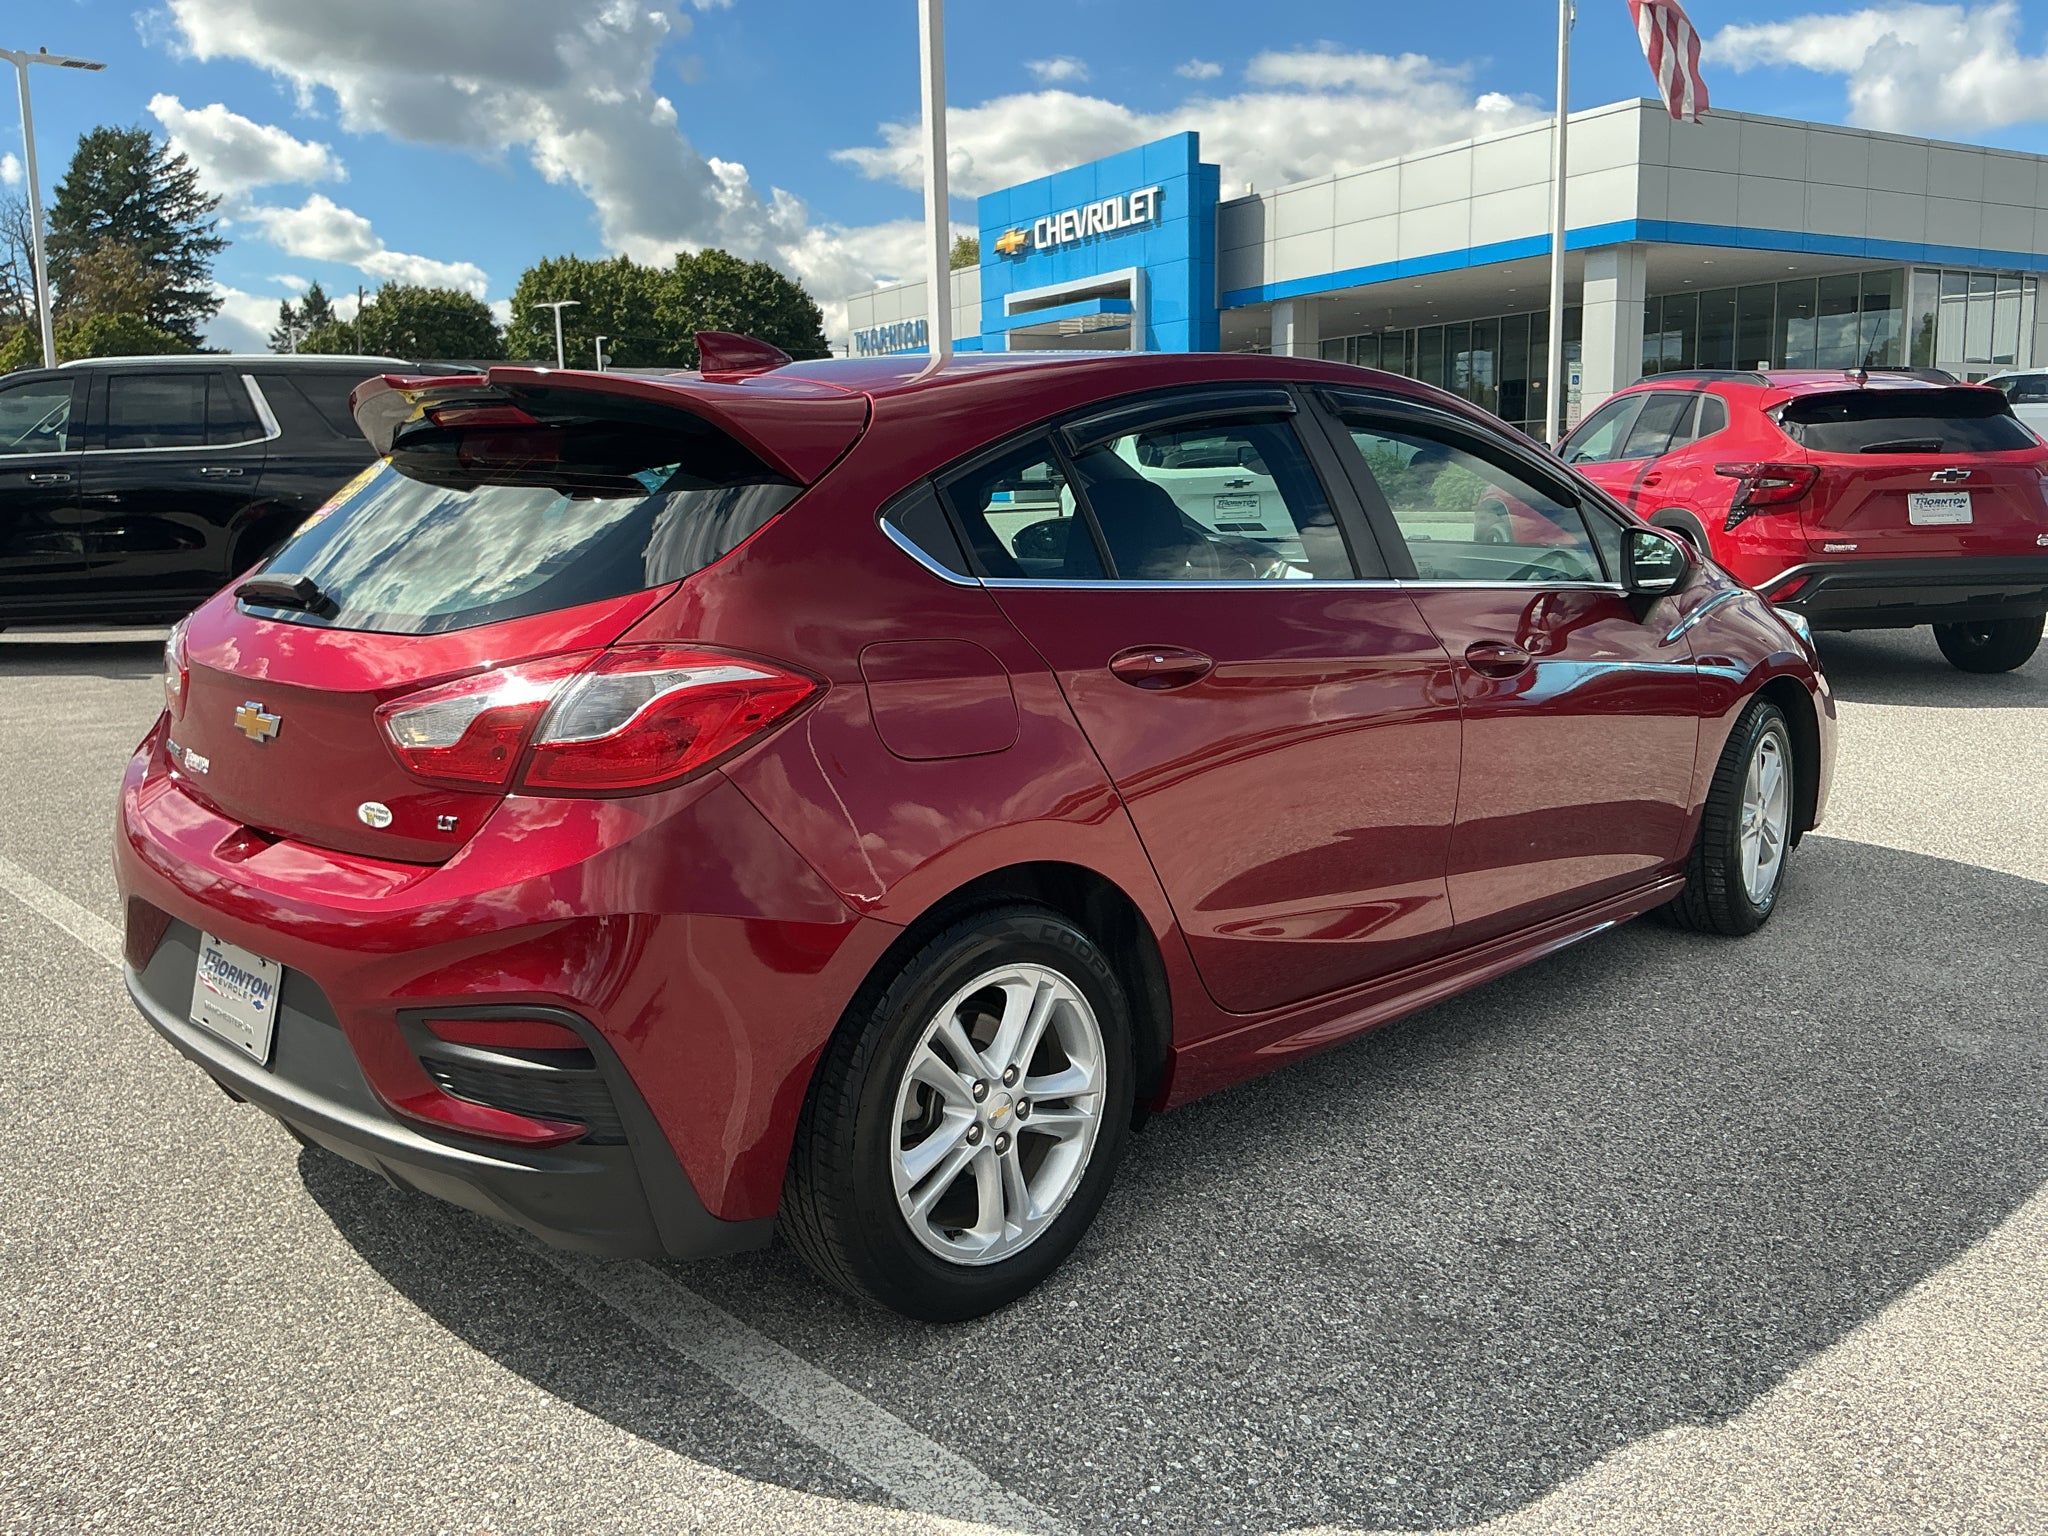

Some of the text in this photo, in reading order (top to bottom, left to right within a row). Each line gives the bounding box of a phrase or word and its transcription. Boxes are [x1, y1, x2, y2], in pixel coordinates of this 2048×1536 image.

[1034, 185, 1162, 250] CHEVROLET
[1914, 497, 1967, 506] THORNTON
[437, 815, 458, 831] LT
[204, 947, 272, 1000] THORNTON
[207, 971, 254, 1000] CHEVROLET
